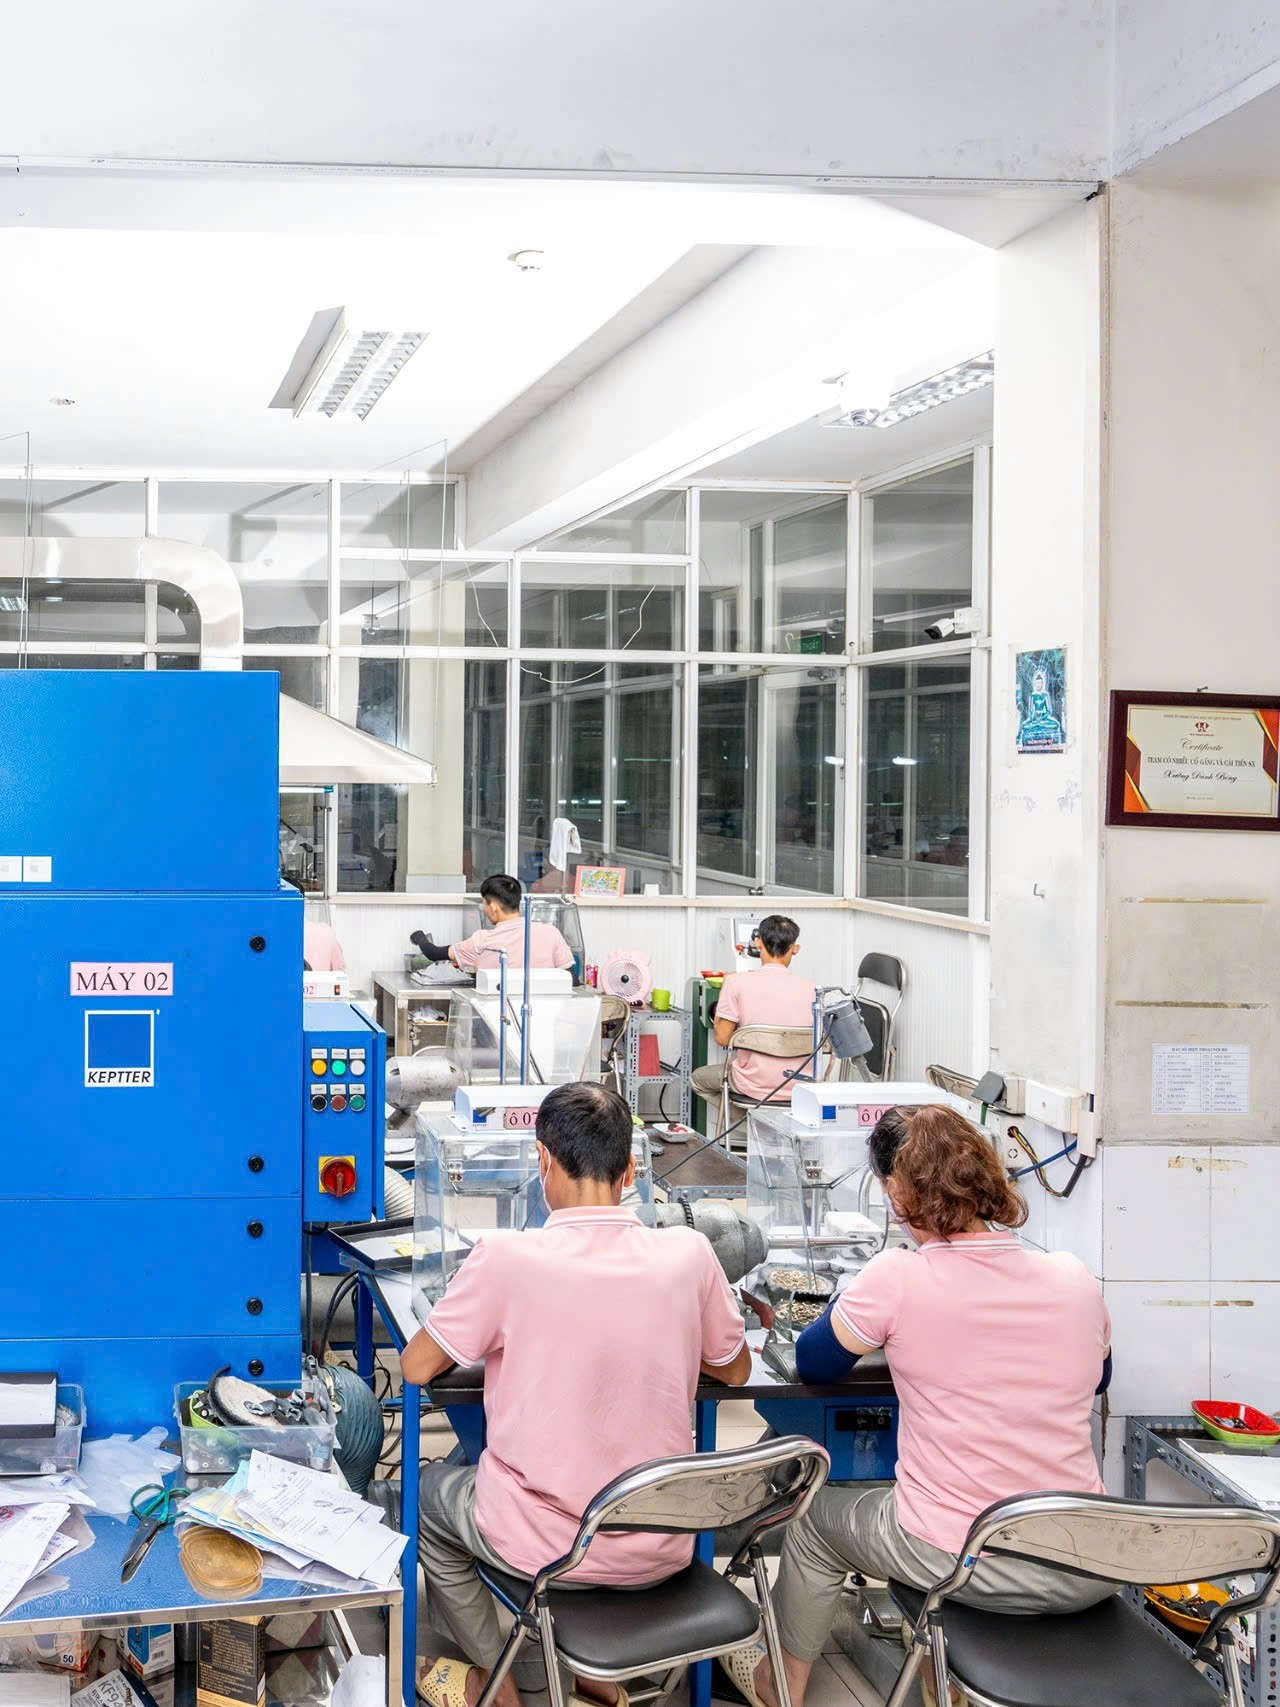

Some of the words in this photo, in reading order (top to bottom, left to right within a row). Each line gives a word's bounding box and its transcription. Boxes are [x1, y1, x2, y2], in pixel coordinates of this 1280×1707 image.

[1180, 738, 1223, 753] Certificate
[76, 966, 136, 991] MÁY
[143, 972, 168, 991] 02
[87, 1071, 151, 1083] KEPTTER
[509, 1112, 518, 1126] ô
[861, 1108, 870, 1122] ô
[874, 1108, 883, 1122] 0
[62, 1654, 74, 1663] 50
[98, 1680, 124, 1707] KF94
